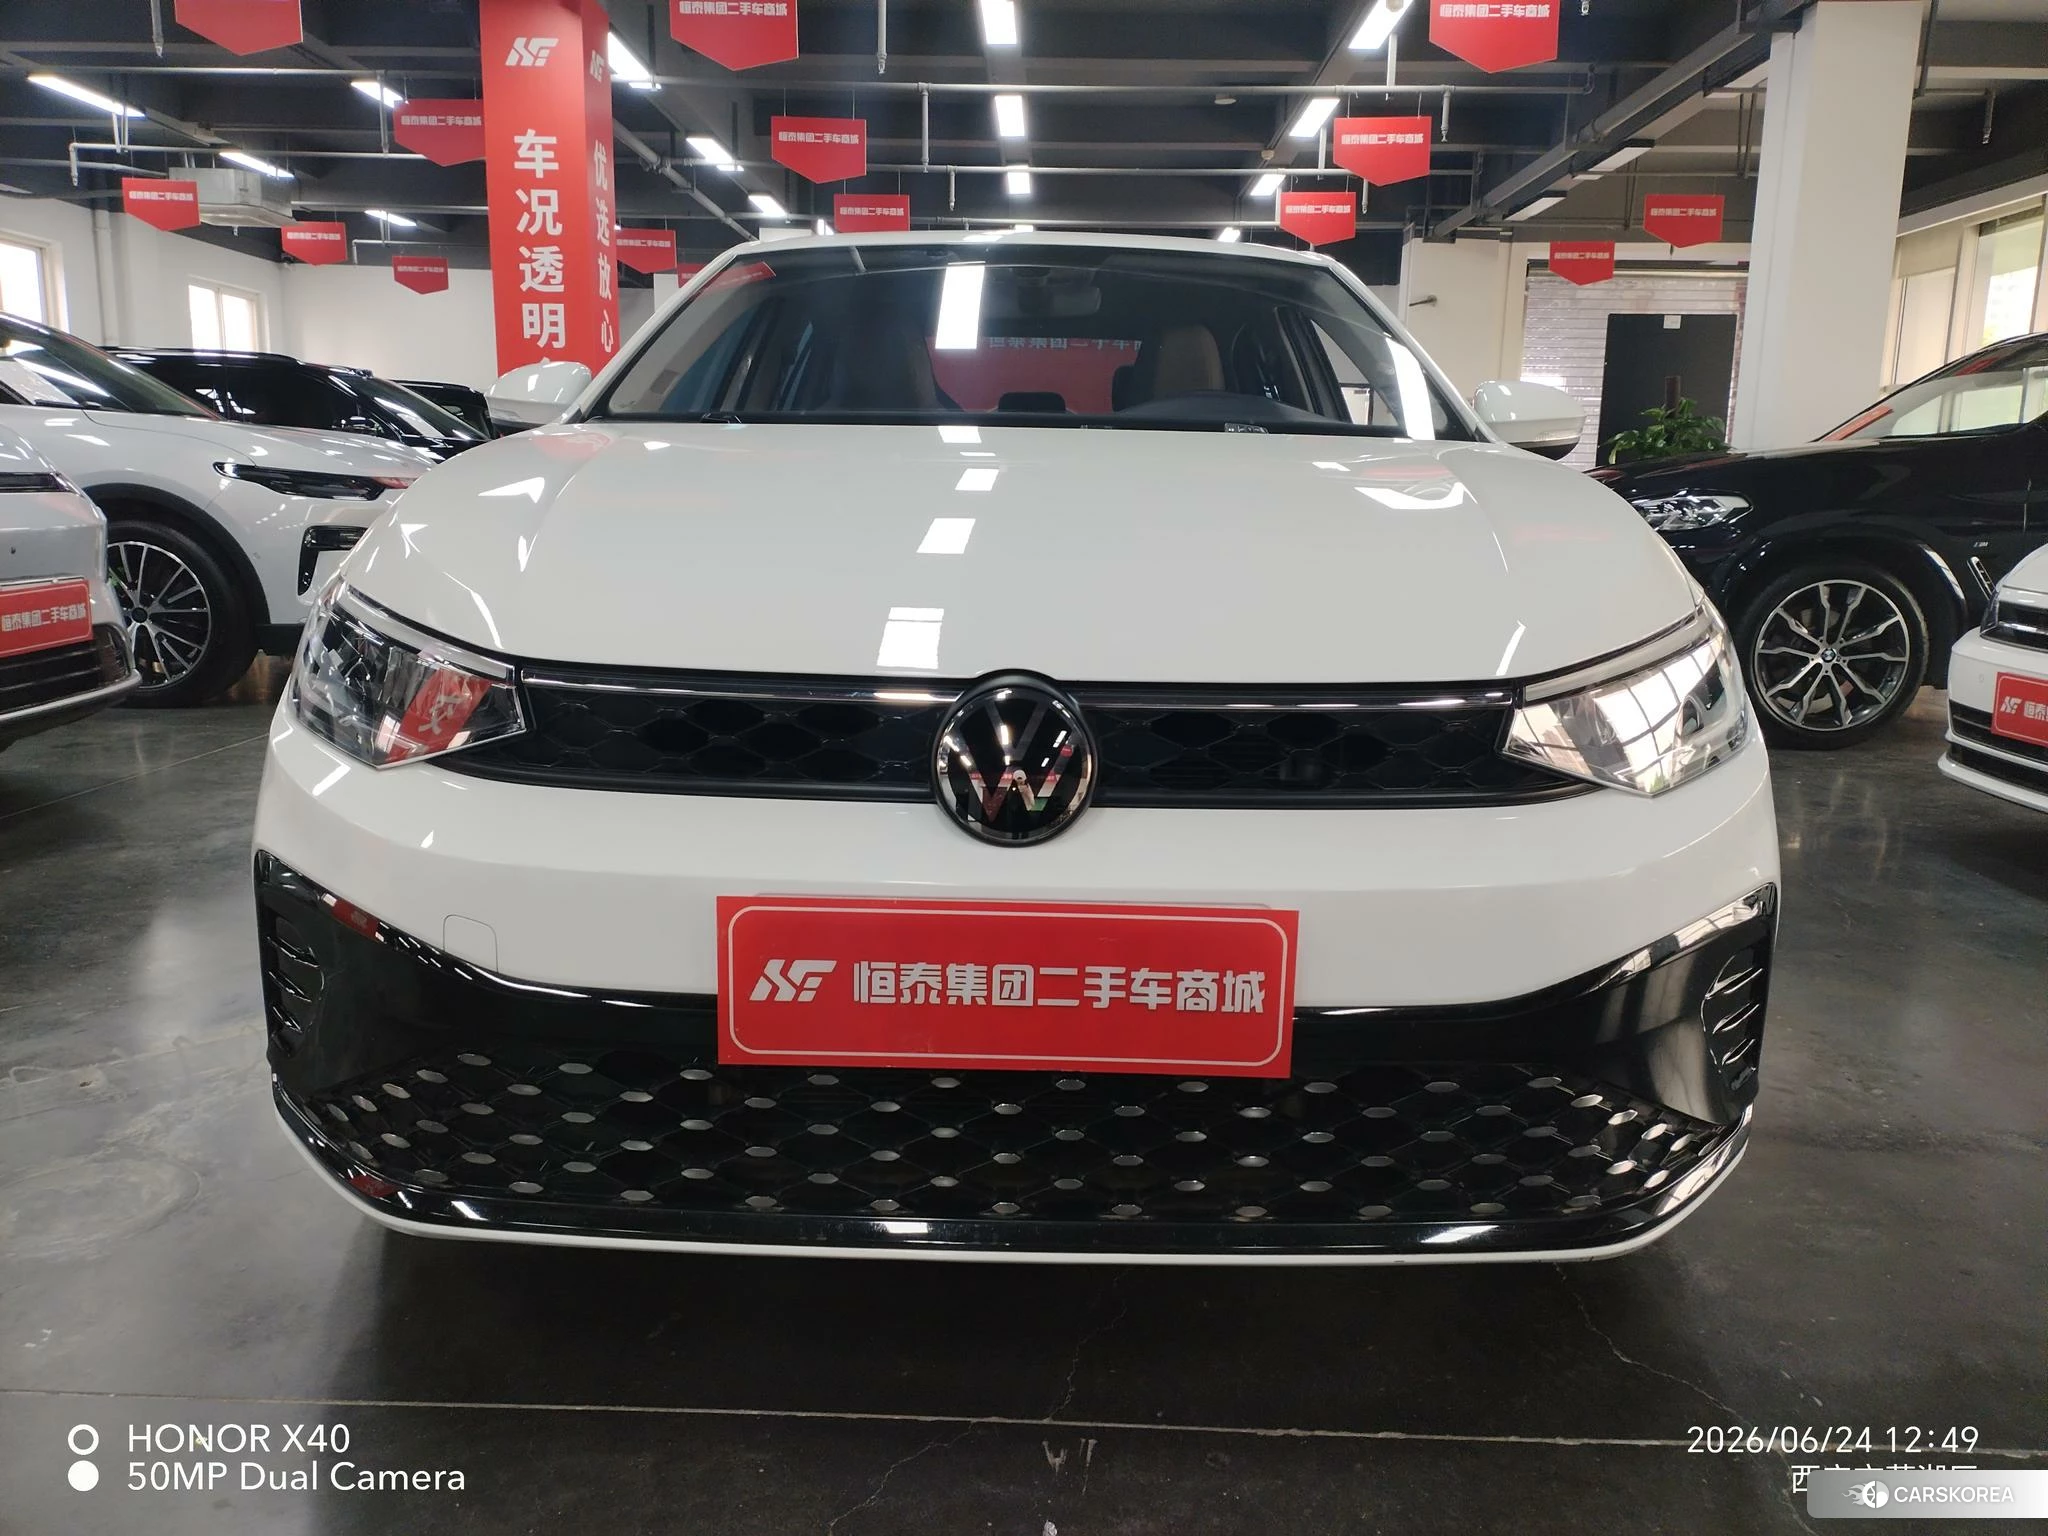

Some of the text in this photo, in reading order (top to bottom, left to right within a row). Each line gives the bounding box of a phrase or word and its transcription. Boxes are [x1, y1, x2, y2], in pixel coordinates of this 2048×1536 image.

[514, 129, 566, 365] 车况透明
[593, 139, 614, 353] 优选放心
[853, 961, 1266, 1013] 恒泰集团二手车商城
